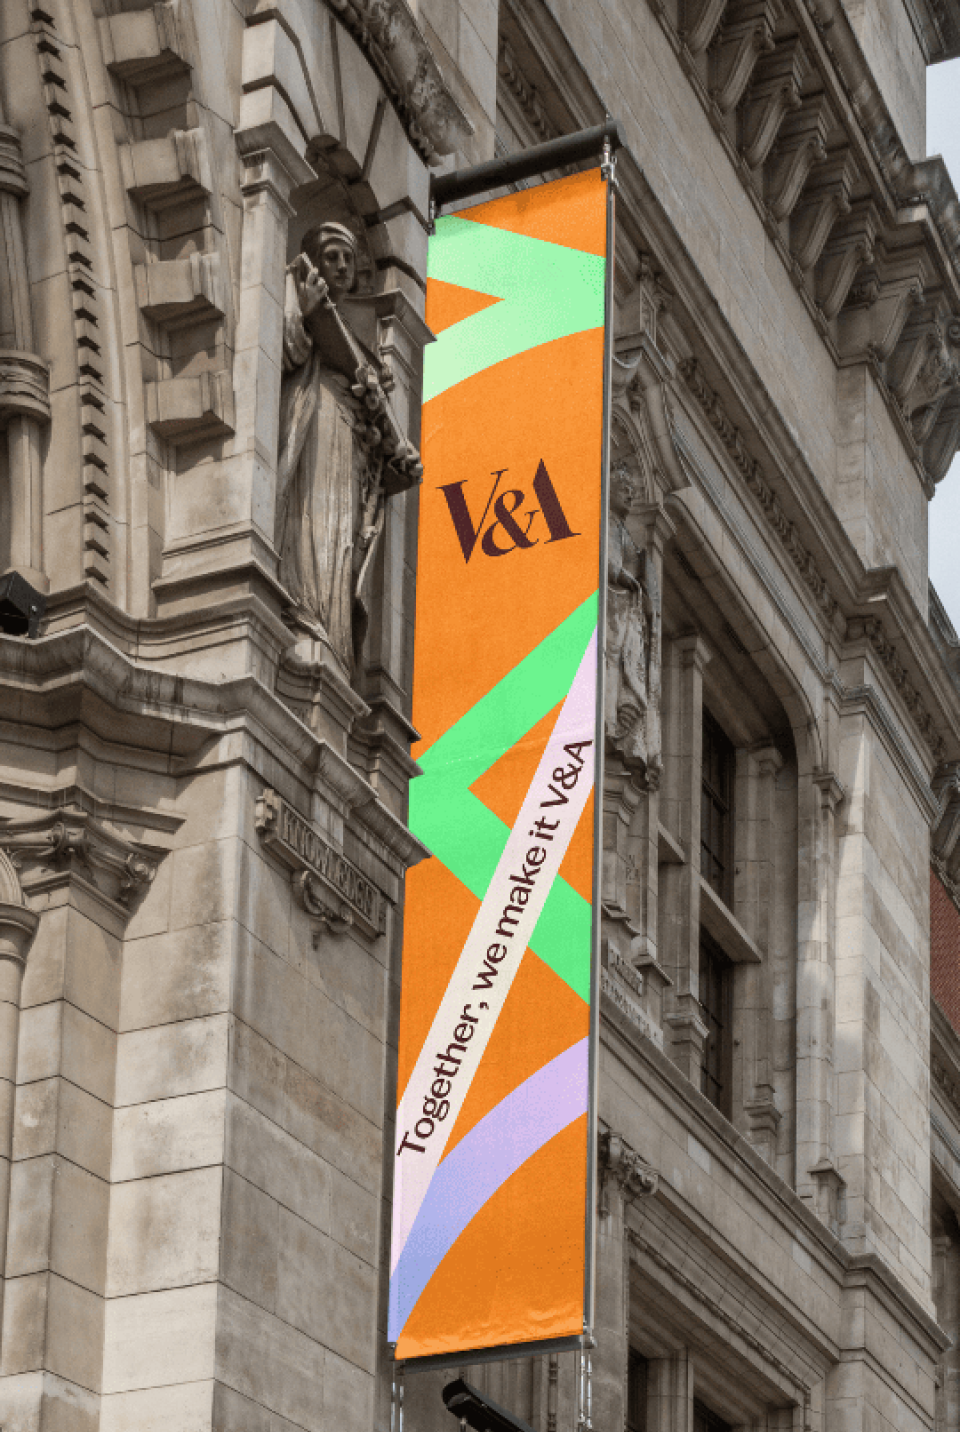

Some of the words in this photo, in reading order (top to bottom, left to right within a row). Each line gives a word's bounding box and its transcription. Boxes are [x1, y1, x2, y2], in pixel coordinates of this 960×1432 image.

[436, 458, 582, 564] V&A
[539, 739, 594, 808] V&A
[528, 816, 561, 841] it
[495, 846, 547, 938] make
[471, 943, 508, 991] we
[396, 1001, 490, 1157] Together,
